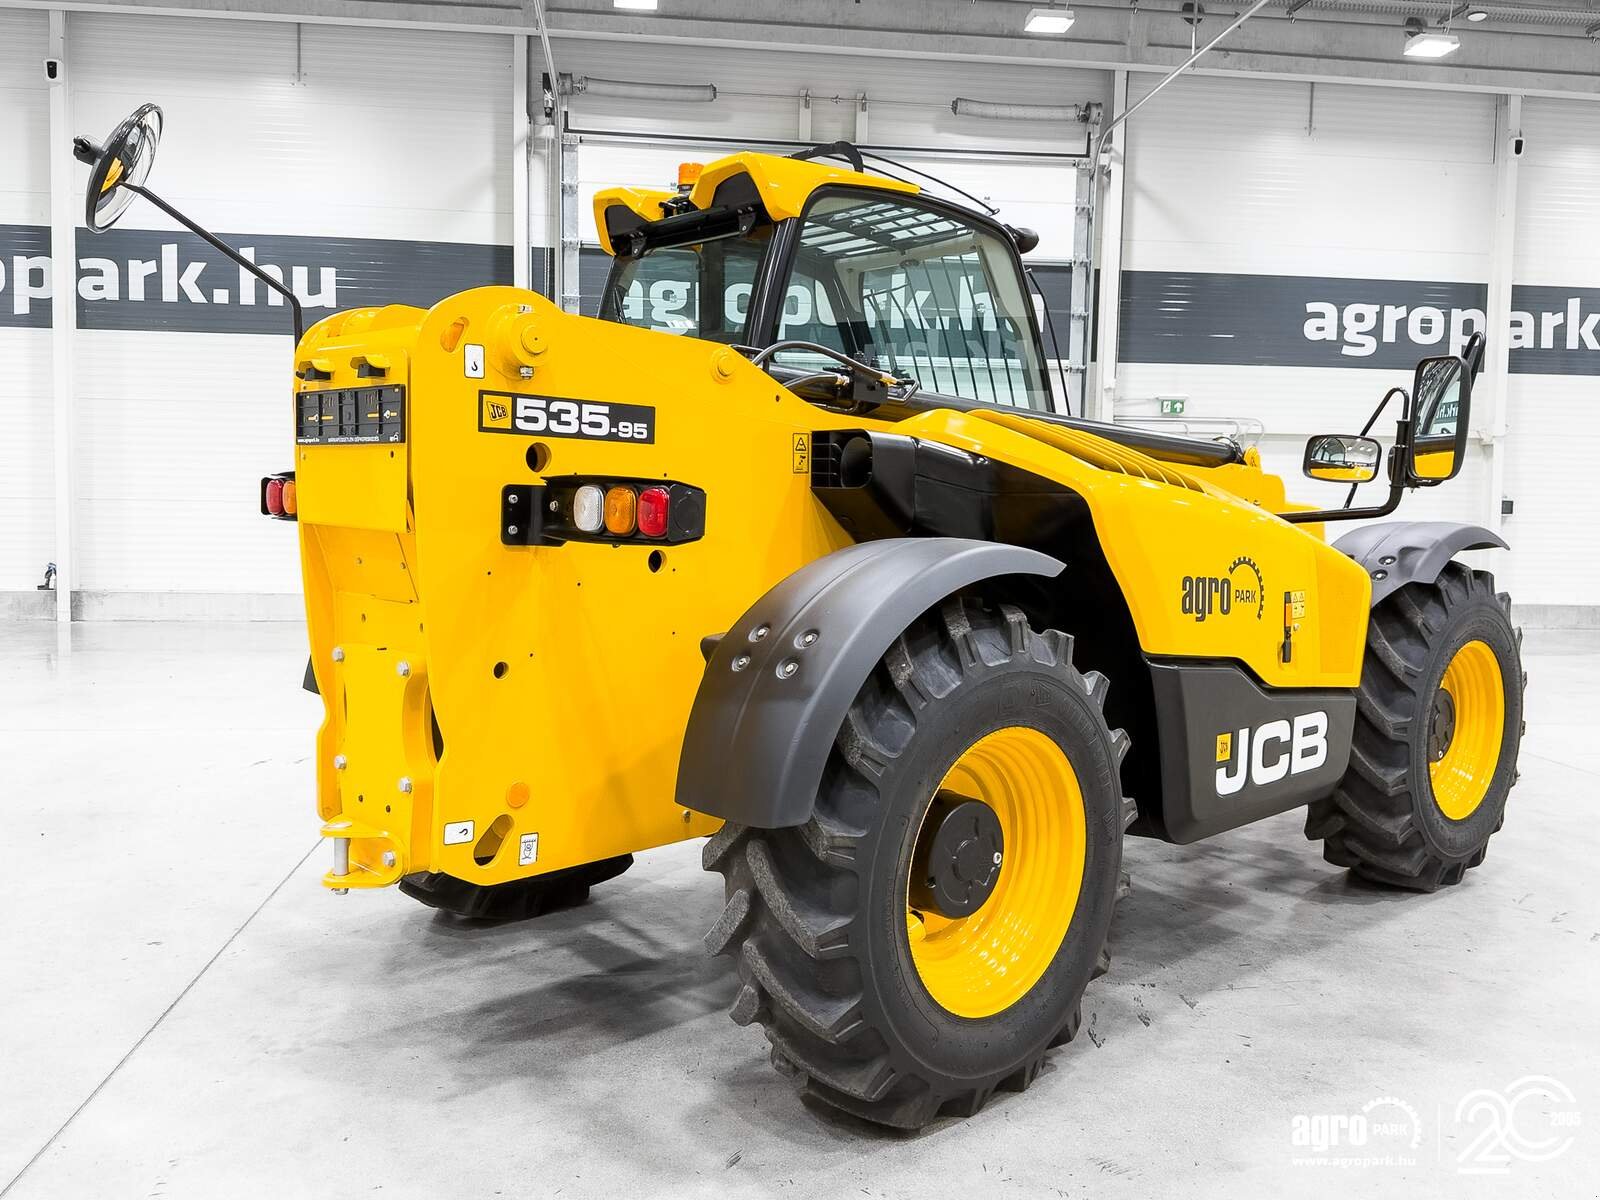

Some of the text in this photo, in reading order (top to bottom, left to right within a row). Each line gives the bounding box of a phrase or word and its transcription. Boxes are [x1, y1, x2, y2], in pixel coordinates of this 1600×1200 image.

[0, 243, 337, 315] park.hu
[491, 397, 648, 439] JCB 535-95
[1181, 576, 1256, 622] agro PARK
[1216, 710, 1328, 796] JCB
